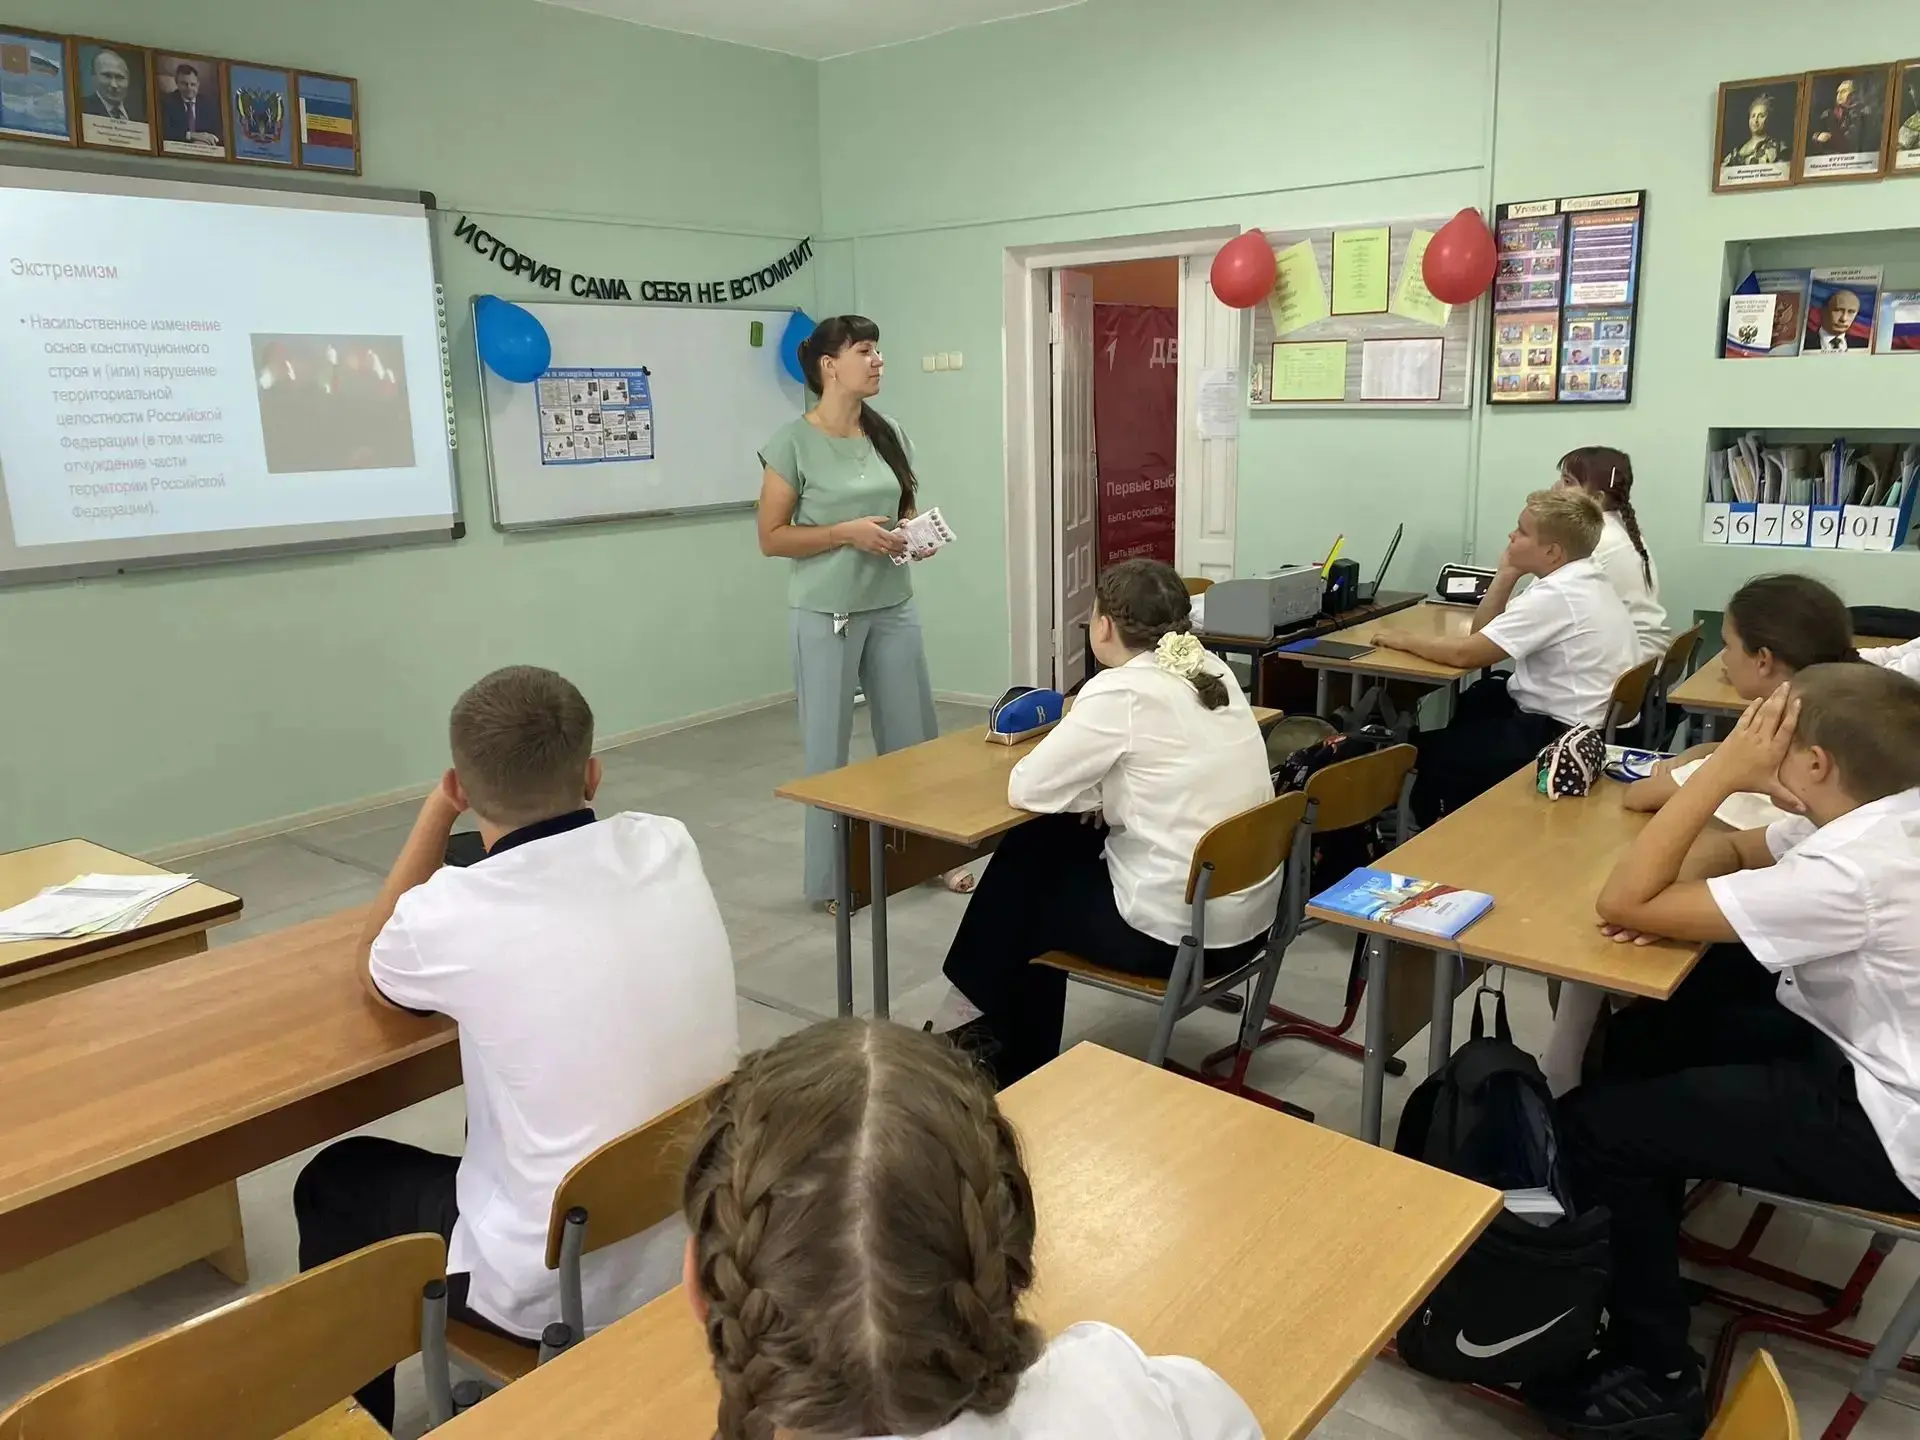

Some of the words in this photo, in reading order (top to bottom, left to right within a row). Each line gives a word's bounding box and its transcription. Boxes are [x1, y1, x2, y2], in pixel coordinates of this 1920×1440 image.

[10, 257, 119, 281] Экстремизм
[453, 216, 562, 291] ИСТОРИЯ
[571, 273, 632, 301] САМА
[640, 280, 692, 303] СЕБЯ
[698, 281, 728, 303] НЕ
[730, 236, 815, 300] ВСПОМНИТ
[30, 314, 147, 331] Насильственное
[150, 318, 223, 332] изменение
[44, 342, 87, 355] основ
[90, 342, 210, 359] конституционного
[48, 365, 89, 380] строя
[92, 366, 101, 378] и
[105, 363, 141, 380] (или)
[143, 364, 218, 381] нарушение
[52, 385, 173, 404] территориальной
[56, 411, 144, 427] целостности
[146, 407, 223, 423] Российской
[60, 434, 139, 451] Федерации
[142, 432, 155, 449] (в
[157, 434, 183, 447] том
[186, 431, 224, 445] числе
[64, 458, 147, 475] отчуждение
[150, 456, 187, 469] части
[69, 481, 149, 498] территории
[150, 473, 226, 492] Российской
[1106, 480, 1152, 497] Первые
[1153, 473, 1175, 490] выб
[1107, 512, 1126, 523] БЫТЬ
[1711, 516, 1725, 535] 5
[1736, 514, 1750, 534] 6
[1764, 516, 1778, 536] 7
[1790, 509, 1805, 530] 8
[1819, 516, 1834, 537] 9
